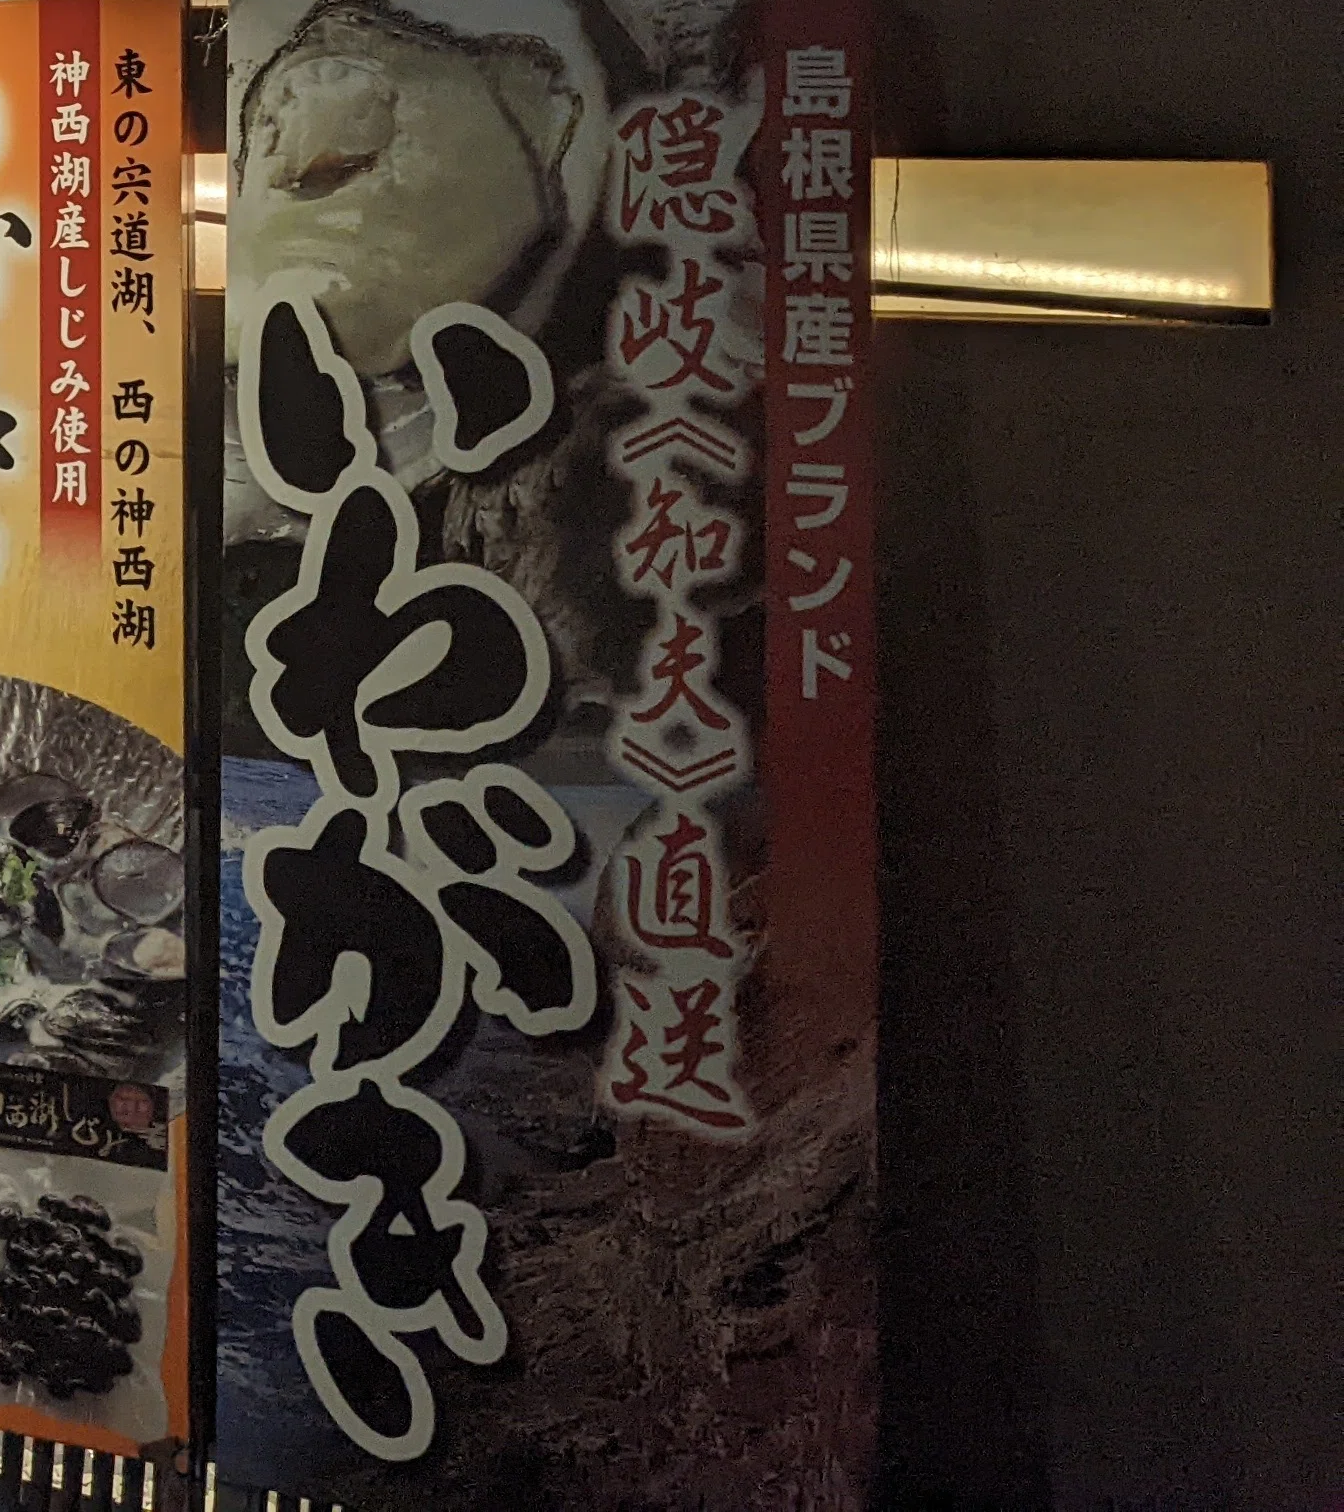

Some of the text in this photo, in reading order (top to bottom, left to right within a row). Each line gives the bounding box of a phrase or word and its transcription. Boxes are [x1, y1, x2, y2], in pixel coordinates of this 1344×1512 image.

[49, 51, 92, 508] 神西湖産しじみ使用
[109, 48, 157, 651] 東の宍道湖、 西の神西湖
[779, 45, 858, 701] 島根県産ブランド
[244, 292, 595, 1460] いわがき
[612, 97, 750, 1133] 隠岐《知夫》直送
